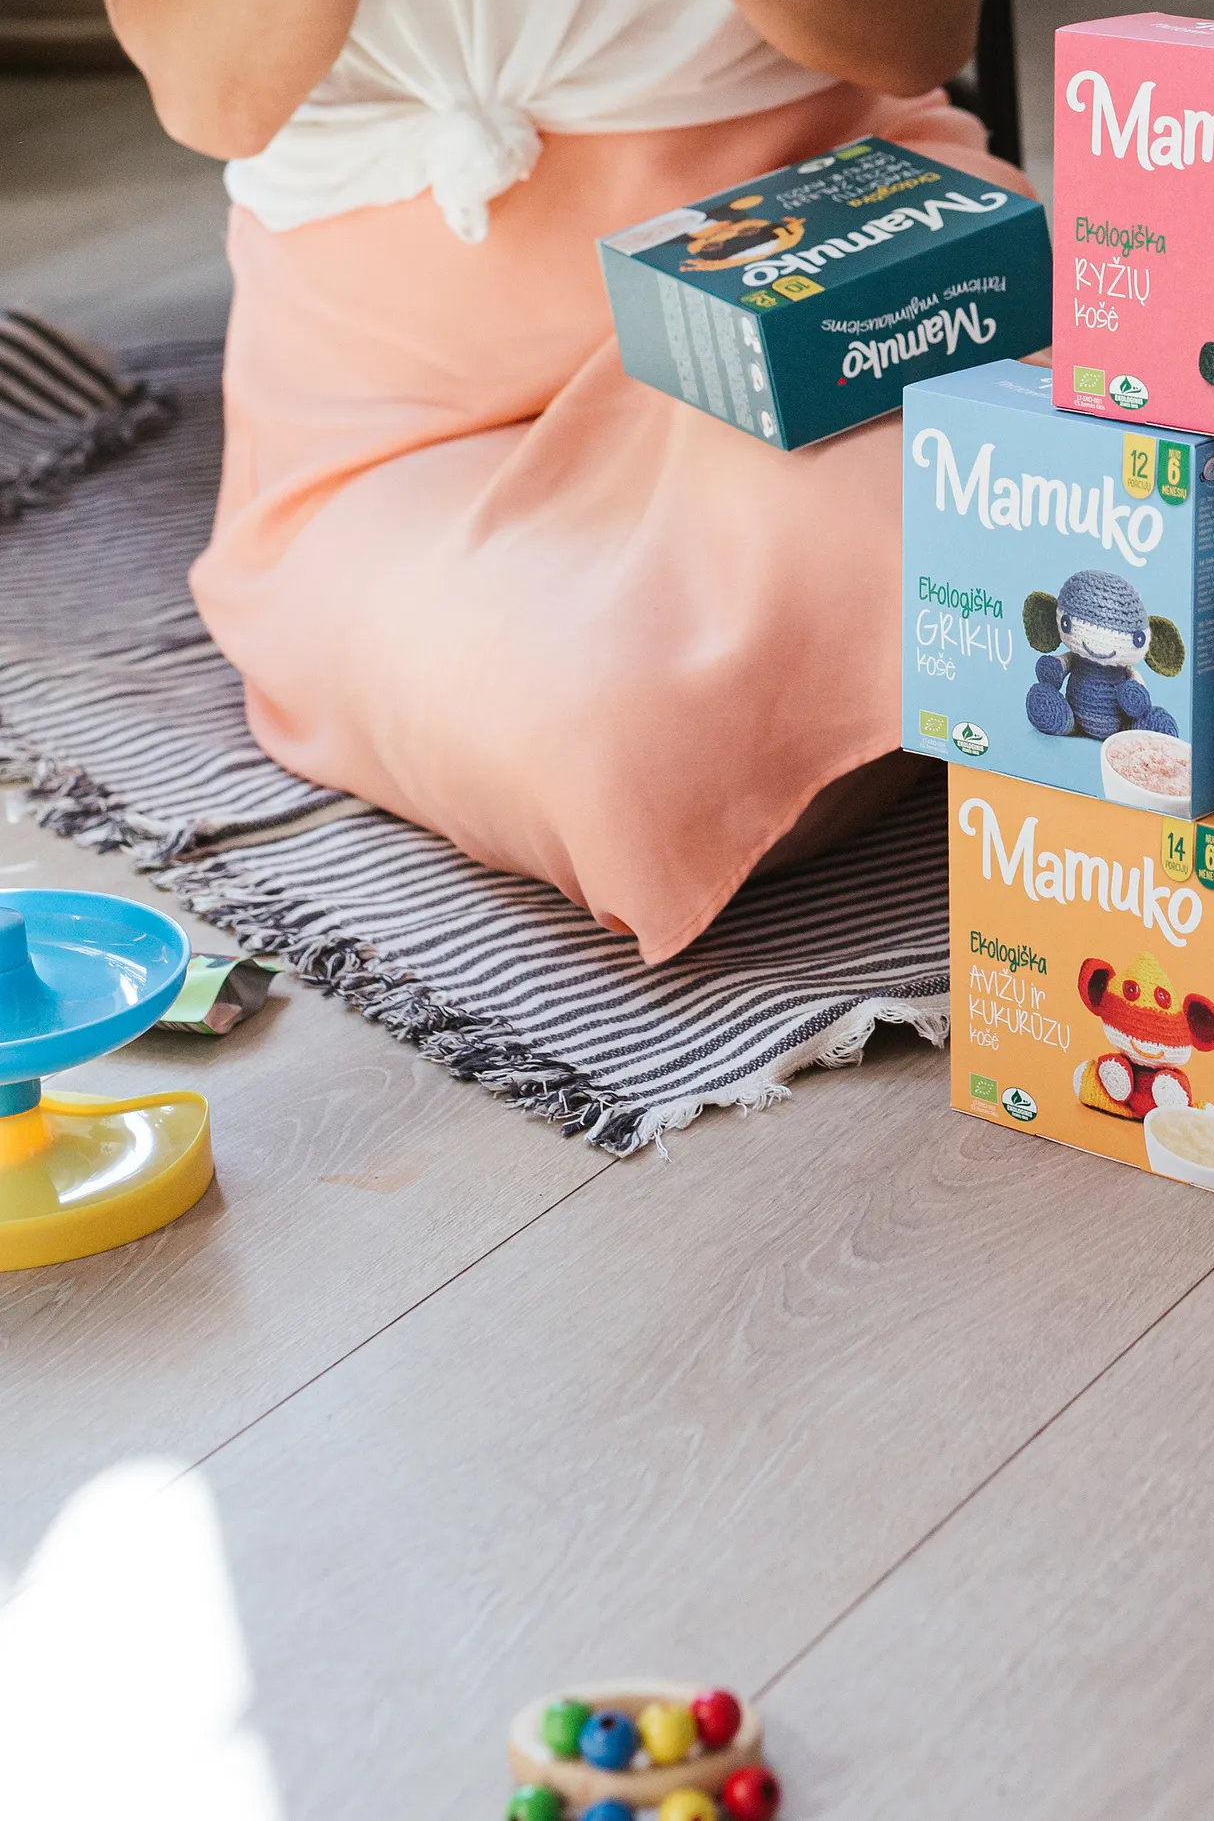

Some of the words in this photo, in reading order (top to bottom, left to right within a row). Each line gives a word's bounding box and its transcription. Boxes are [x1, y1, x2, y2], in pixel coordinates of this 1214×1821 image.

[742, 191, 1008, 287] Mamuko
[1075, 216, 1166, 258] Ekologiška
[1074, 256, 1150, 306] RYŽIŲ
[1074, 297, 1119, 332] košė
[842, 301, 997, 379] Mamuko
[1131, 449, 1148, 479] 12
[1167, 457, 1181, 486] 6
[912, 428, 1164, 567] Mamuko
[919, 576, 1003, 619] Ekologiška
[916, 609, 1013, 671] GRIKIŲ
[916, 646, 956, 681] košė
[1167, 832, 1186, 862] 14
[958, 797, 1203, 948] Mamuko
[970, 930, 1047, 975] Ekologiška
[970, 964, 1026, 1008] AVIŽŲ
[1031, 982, 1046, 1010] ir
[969, 994, 1071, 1053] KUKURŪZŲ
[969, 1022, 1000, 1051] košė
